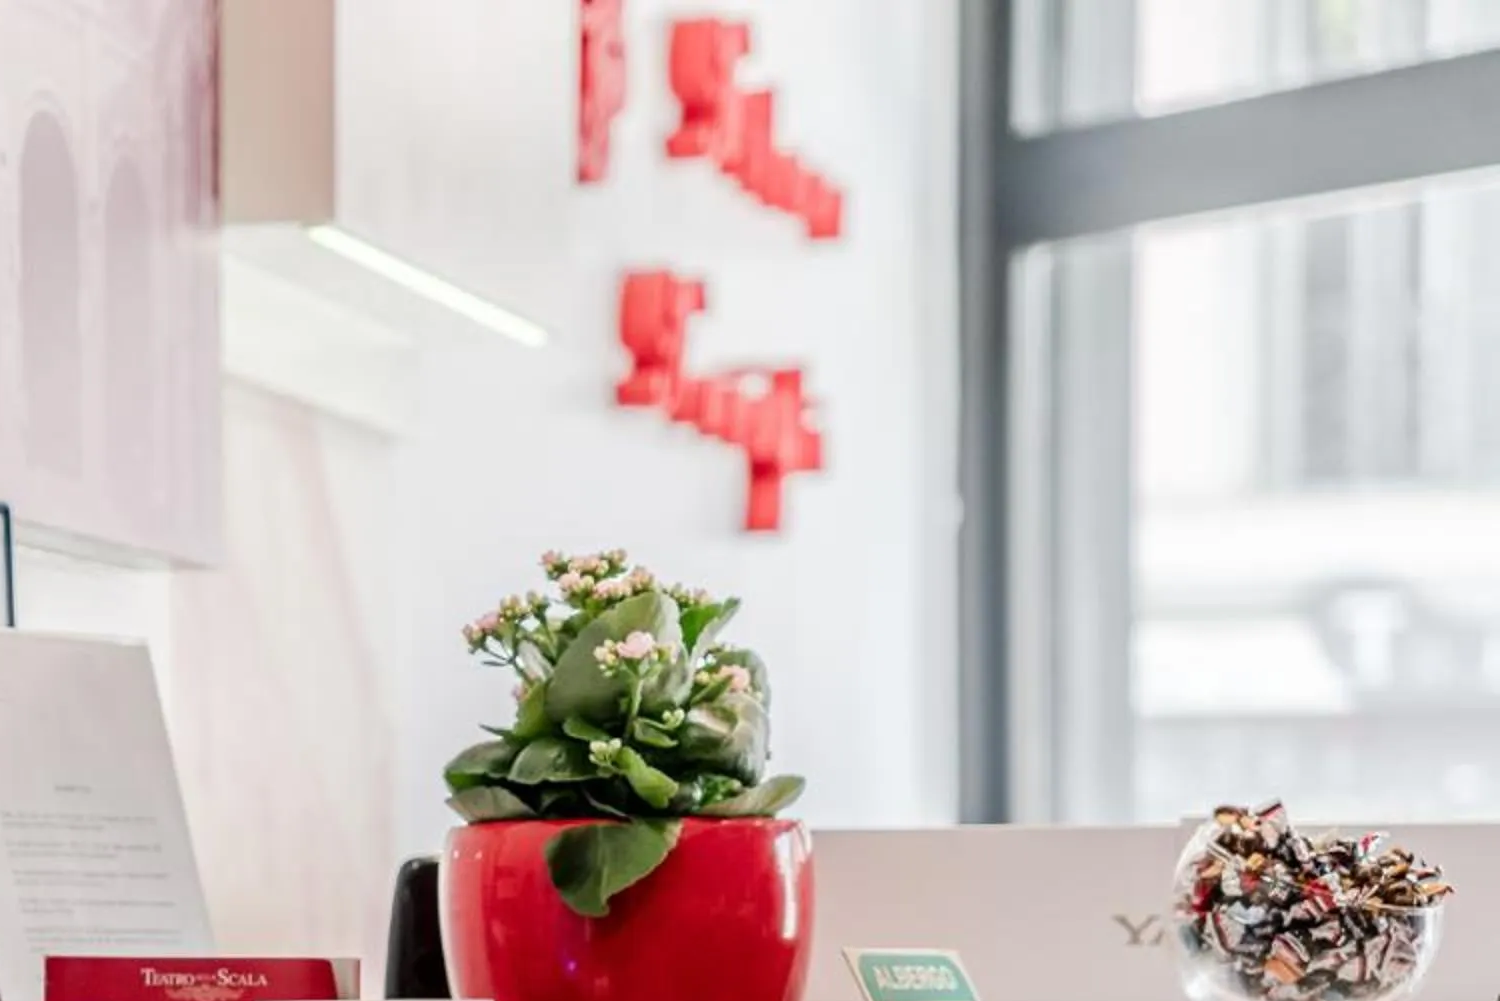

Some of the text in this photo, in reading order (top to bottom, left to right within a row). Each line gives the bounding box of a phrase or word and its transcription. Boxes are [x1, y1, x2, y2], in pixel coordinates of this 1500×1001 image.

[140, 967, 195, 987] TEATRO
[217, 967, 268, 987] SCALA
[873, 965, 958, 991] ALBERGO
